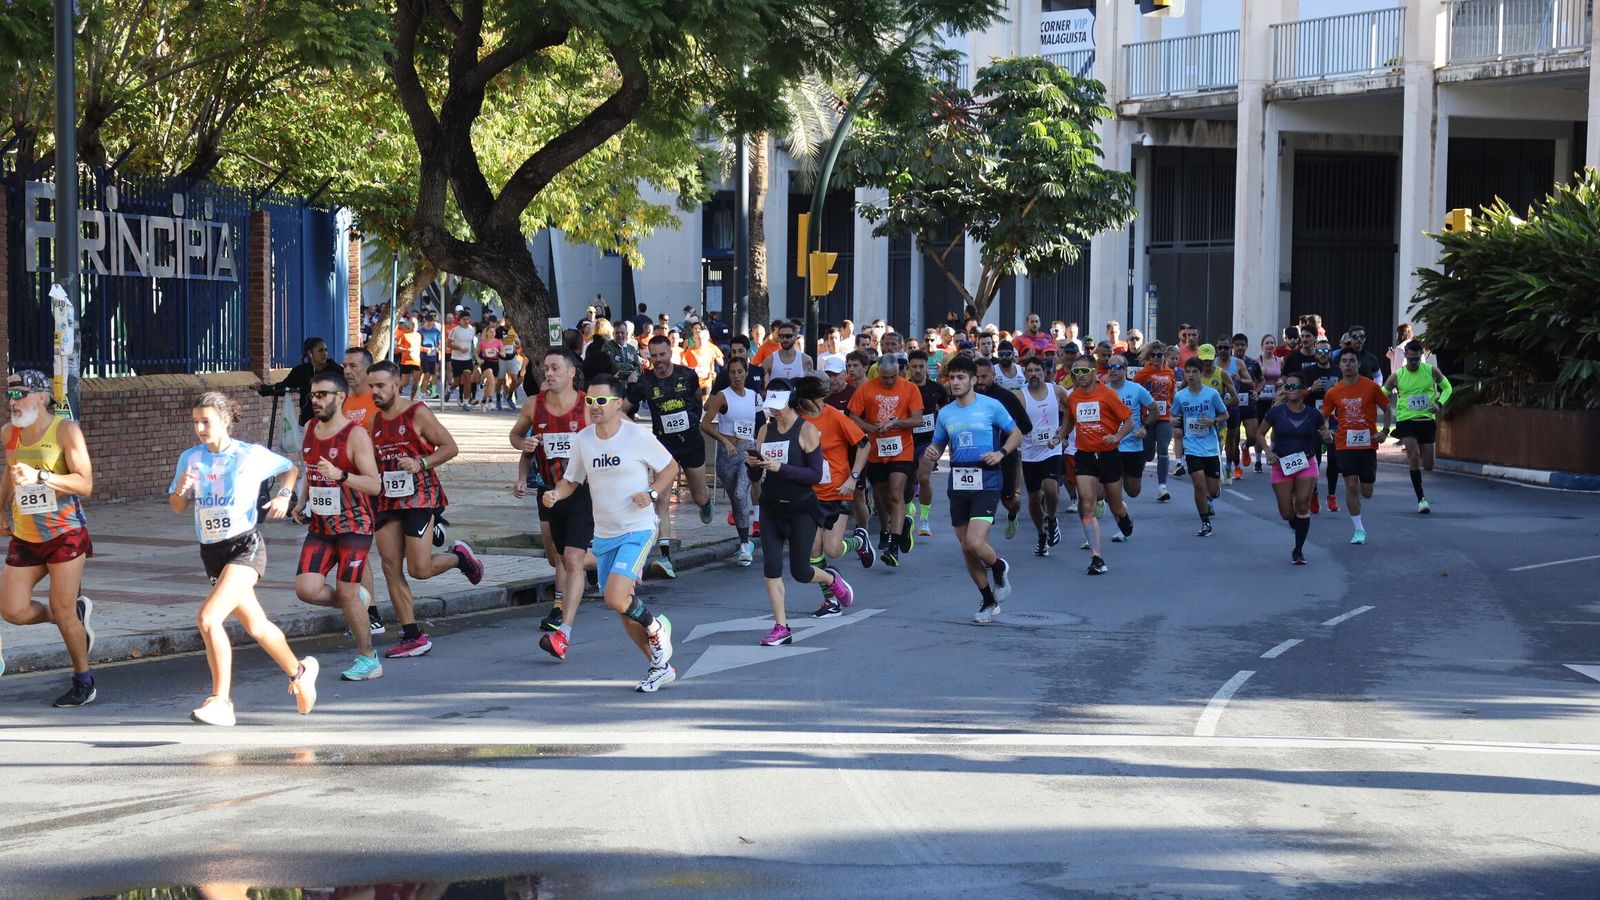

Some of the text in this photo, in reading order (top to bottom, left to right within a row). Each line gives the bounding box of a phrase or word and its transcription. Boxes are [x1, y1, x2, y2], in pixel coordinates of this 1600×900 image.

[1041, 18, 1088, 33] CORNER VIP
[1041, 32, 1087, 45] MALAGUISTA
[1079, 408, 1097, 416] 1737
[1184, 403, 1209, 412] nerja
[666, 418, 685, 428] 422
[737, 426, 753, 434] 521
[548, 441, 571, 451] 755
[880, 443, 898, 452] 348
[592, 453, 621, 468] nike
[1285, 458, 1304, 470] 242
[960, 475, 974, 484] 40
[20, 493, 47, 506] 281
[312, 496, 332, 506] 986
[205, 517, 231, 530] 938
